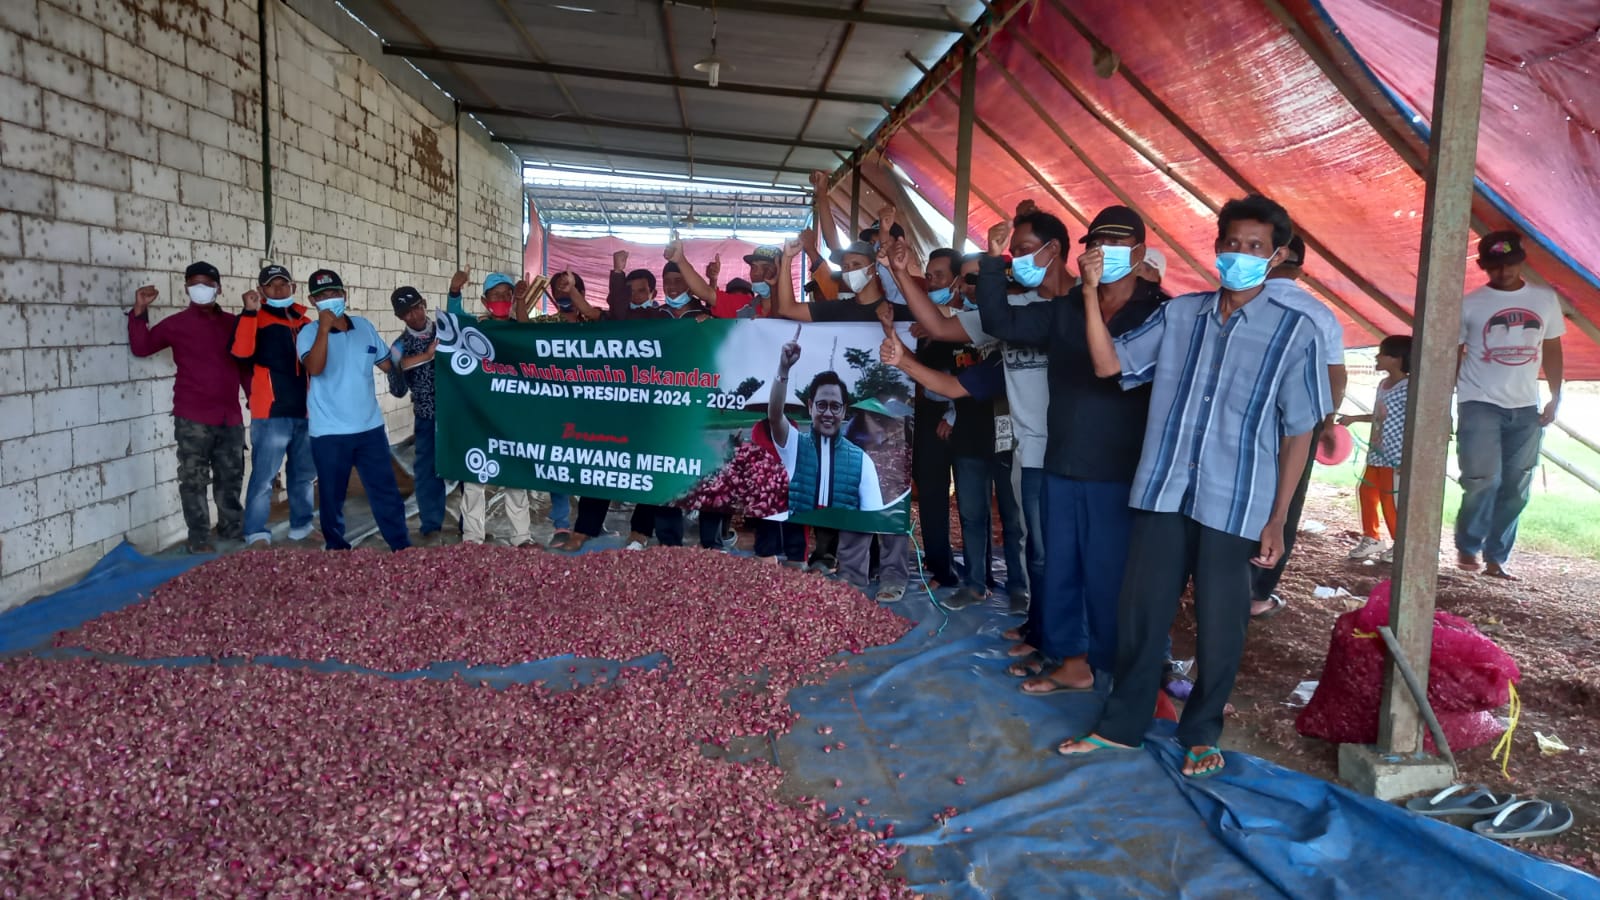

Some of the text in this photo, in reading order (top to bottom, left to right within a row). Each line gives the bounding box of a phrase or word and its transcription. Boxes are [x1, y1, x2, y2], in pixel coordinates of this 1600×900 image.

[535, 339, 662, 358] DEKLARASI
[519, 362, 627, 383] Muhaimin
[631, 364, 721, 388] Iskandar
[490, 378, 569, 398] MENJADI
[571, 385, 650, 403] PRESIDEN
[653, 389, 691, 406] 2024
[706, 392, 747, 410] 2029
[487, 438, 702, 476] PETANI BAWANG MERAH
[534, 463, 654, 492] KAB. BREBES
